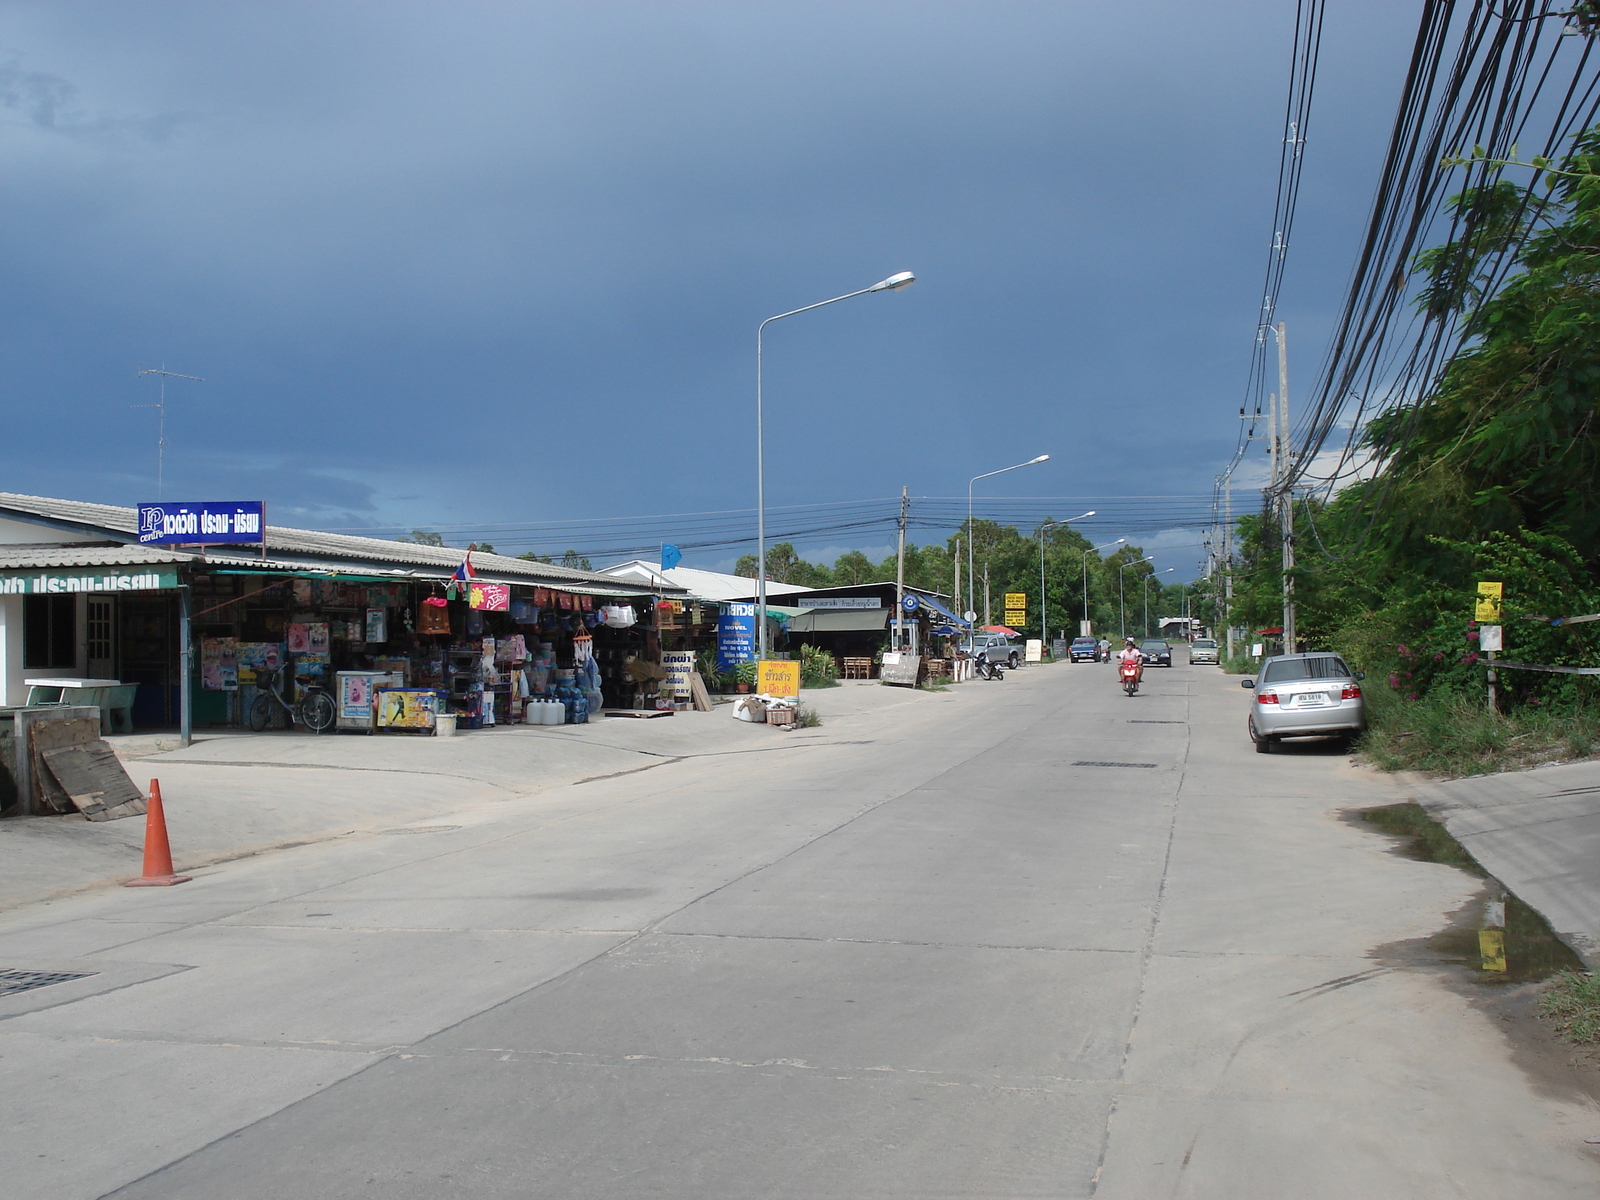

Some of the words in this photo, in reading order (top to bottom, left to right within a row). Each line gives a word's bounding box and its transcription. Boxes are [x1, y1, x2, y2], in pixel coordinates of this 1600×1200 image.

[163, 509, 198, 535] กวดวิชา
[140, 530, 164, 543] centre
[765, 669, 791, 681] ข้าวสาร
